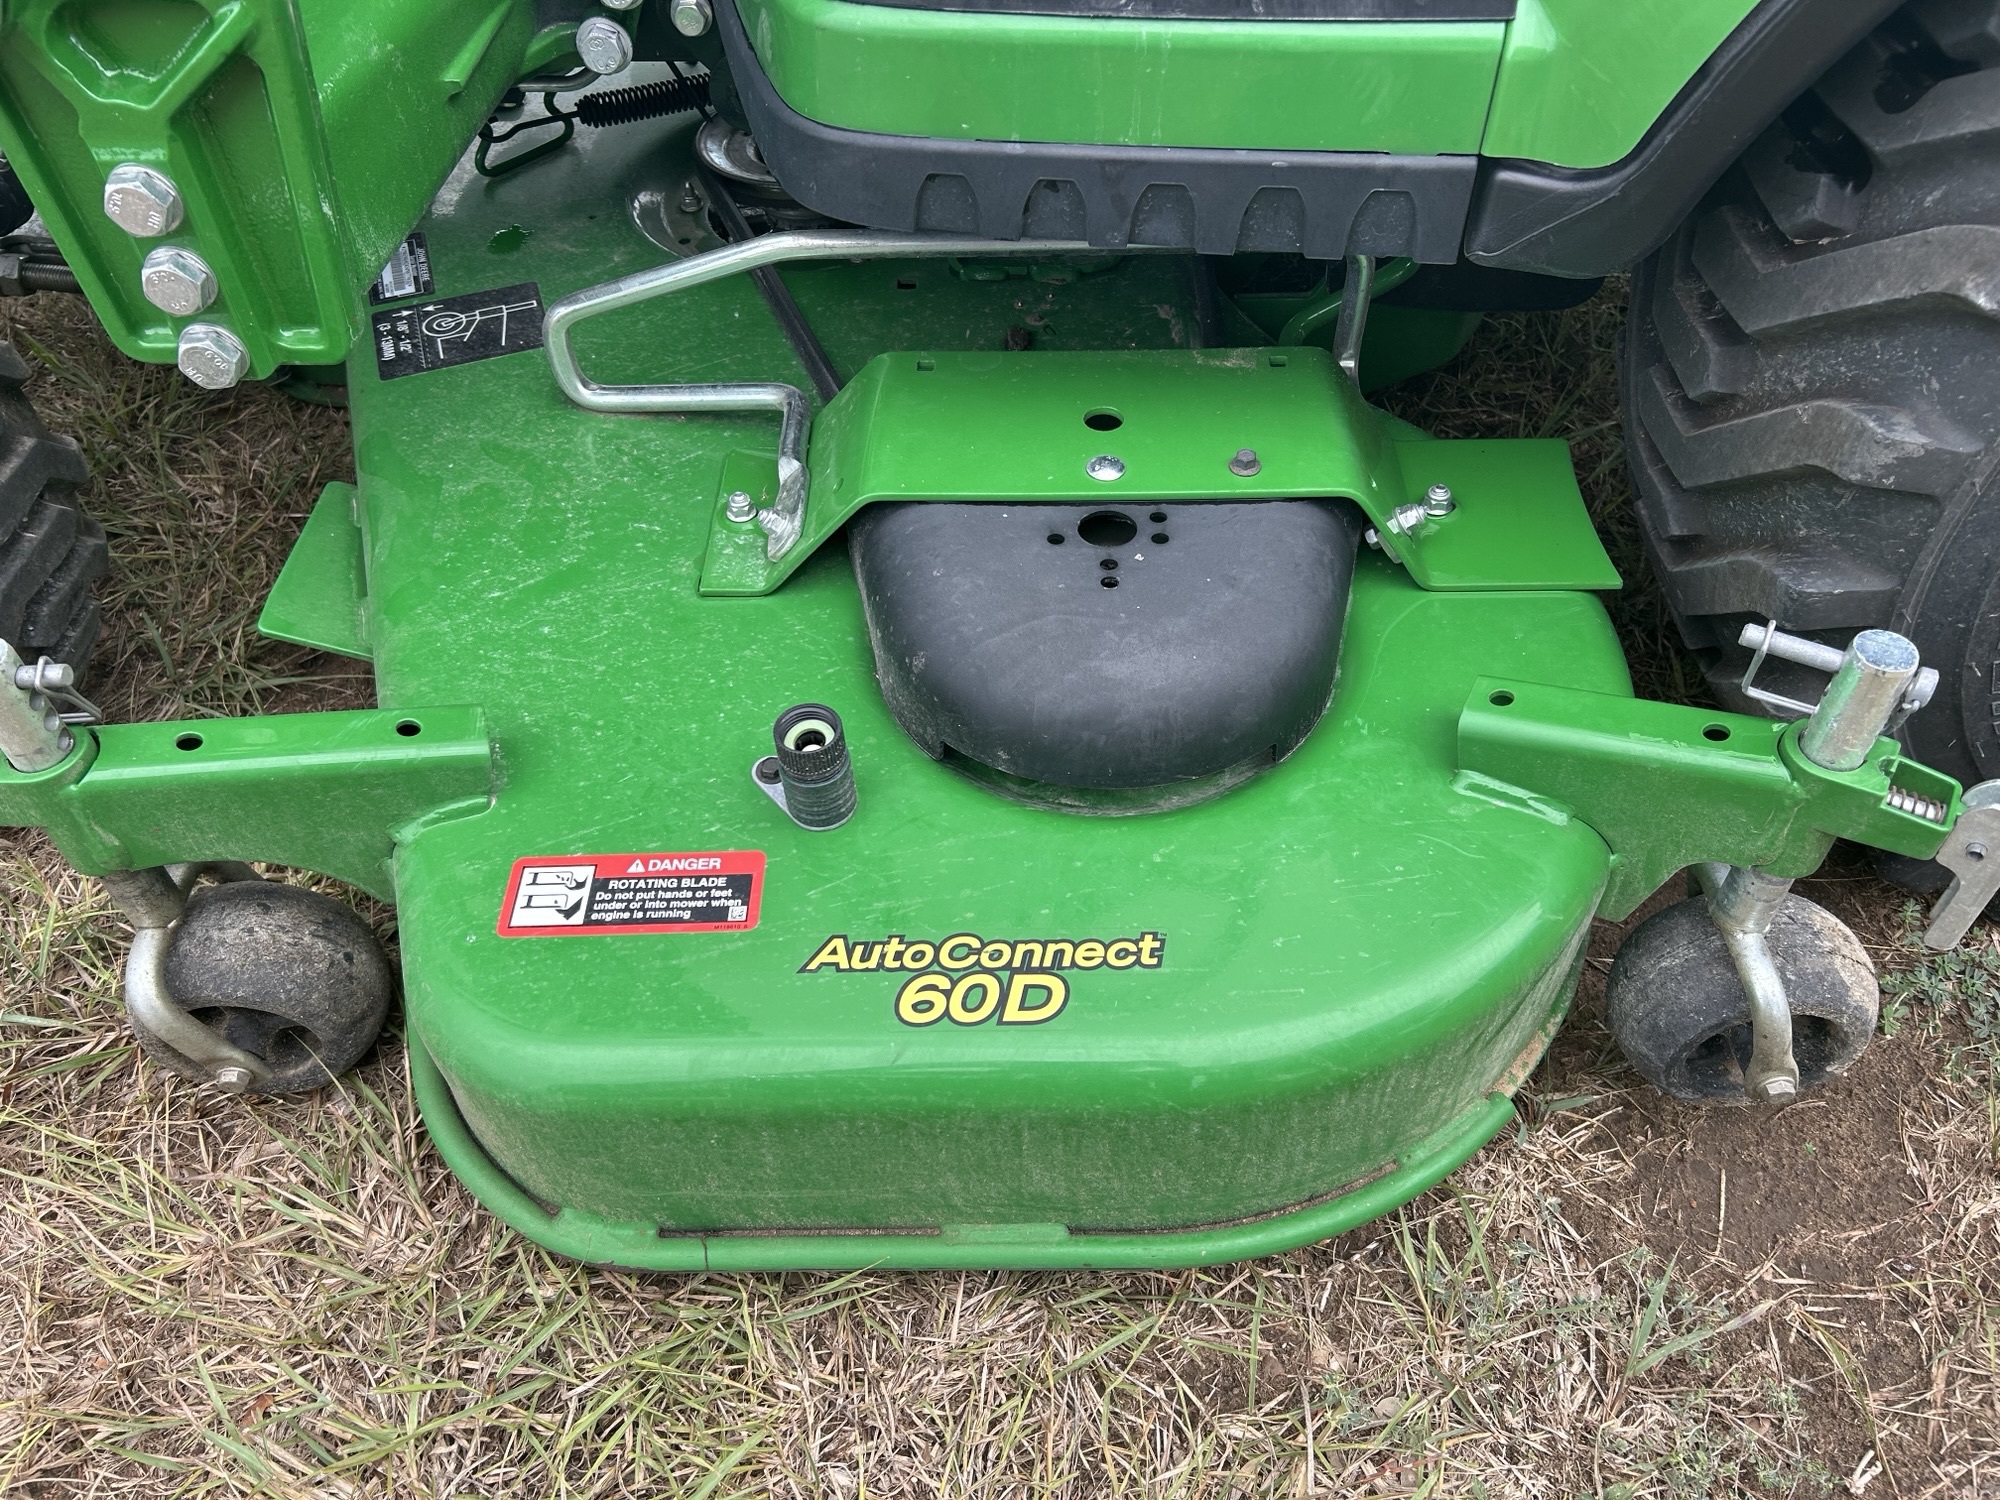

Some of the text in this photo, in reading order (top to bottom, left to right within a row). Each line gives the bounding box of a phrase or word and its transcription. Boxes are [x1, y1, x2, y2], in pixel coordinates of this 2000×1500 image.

[416, 248, 431, 281] JOHN DEERE
[647, 857, 721, 871] DANGER
[608, 877, 727, 890] ROTATING BLADE
[595, 888, 733, 901] Do not put hands or feet
[593, 901, 627, 910] under
[644, 899, 667, 909] into
[669, 900, 709, 908] mower
[711, 898, 742, 907] when
[591, 909, 692, 921] engine is running
[799, 932, 1165, 972] AutoConnect
[895, 971, 1070, 1027] 60D
